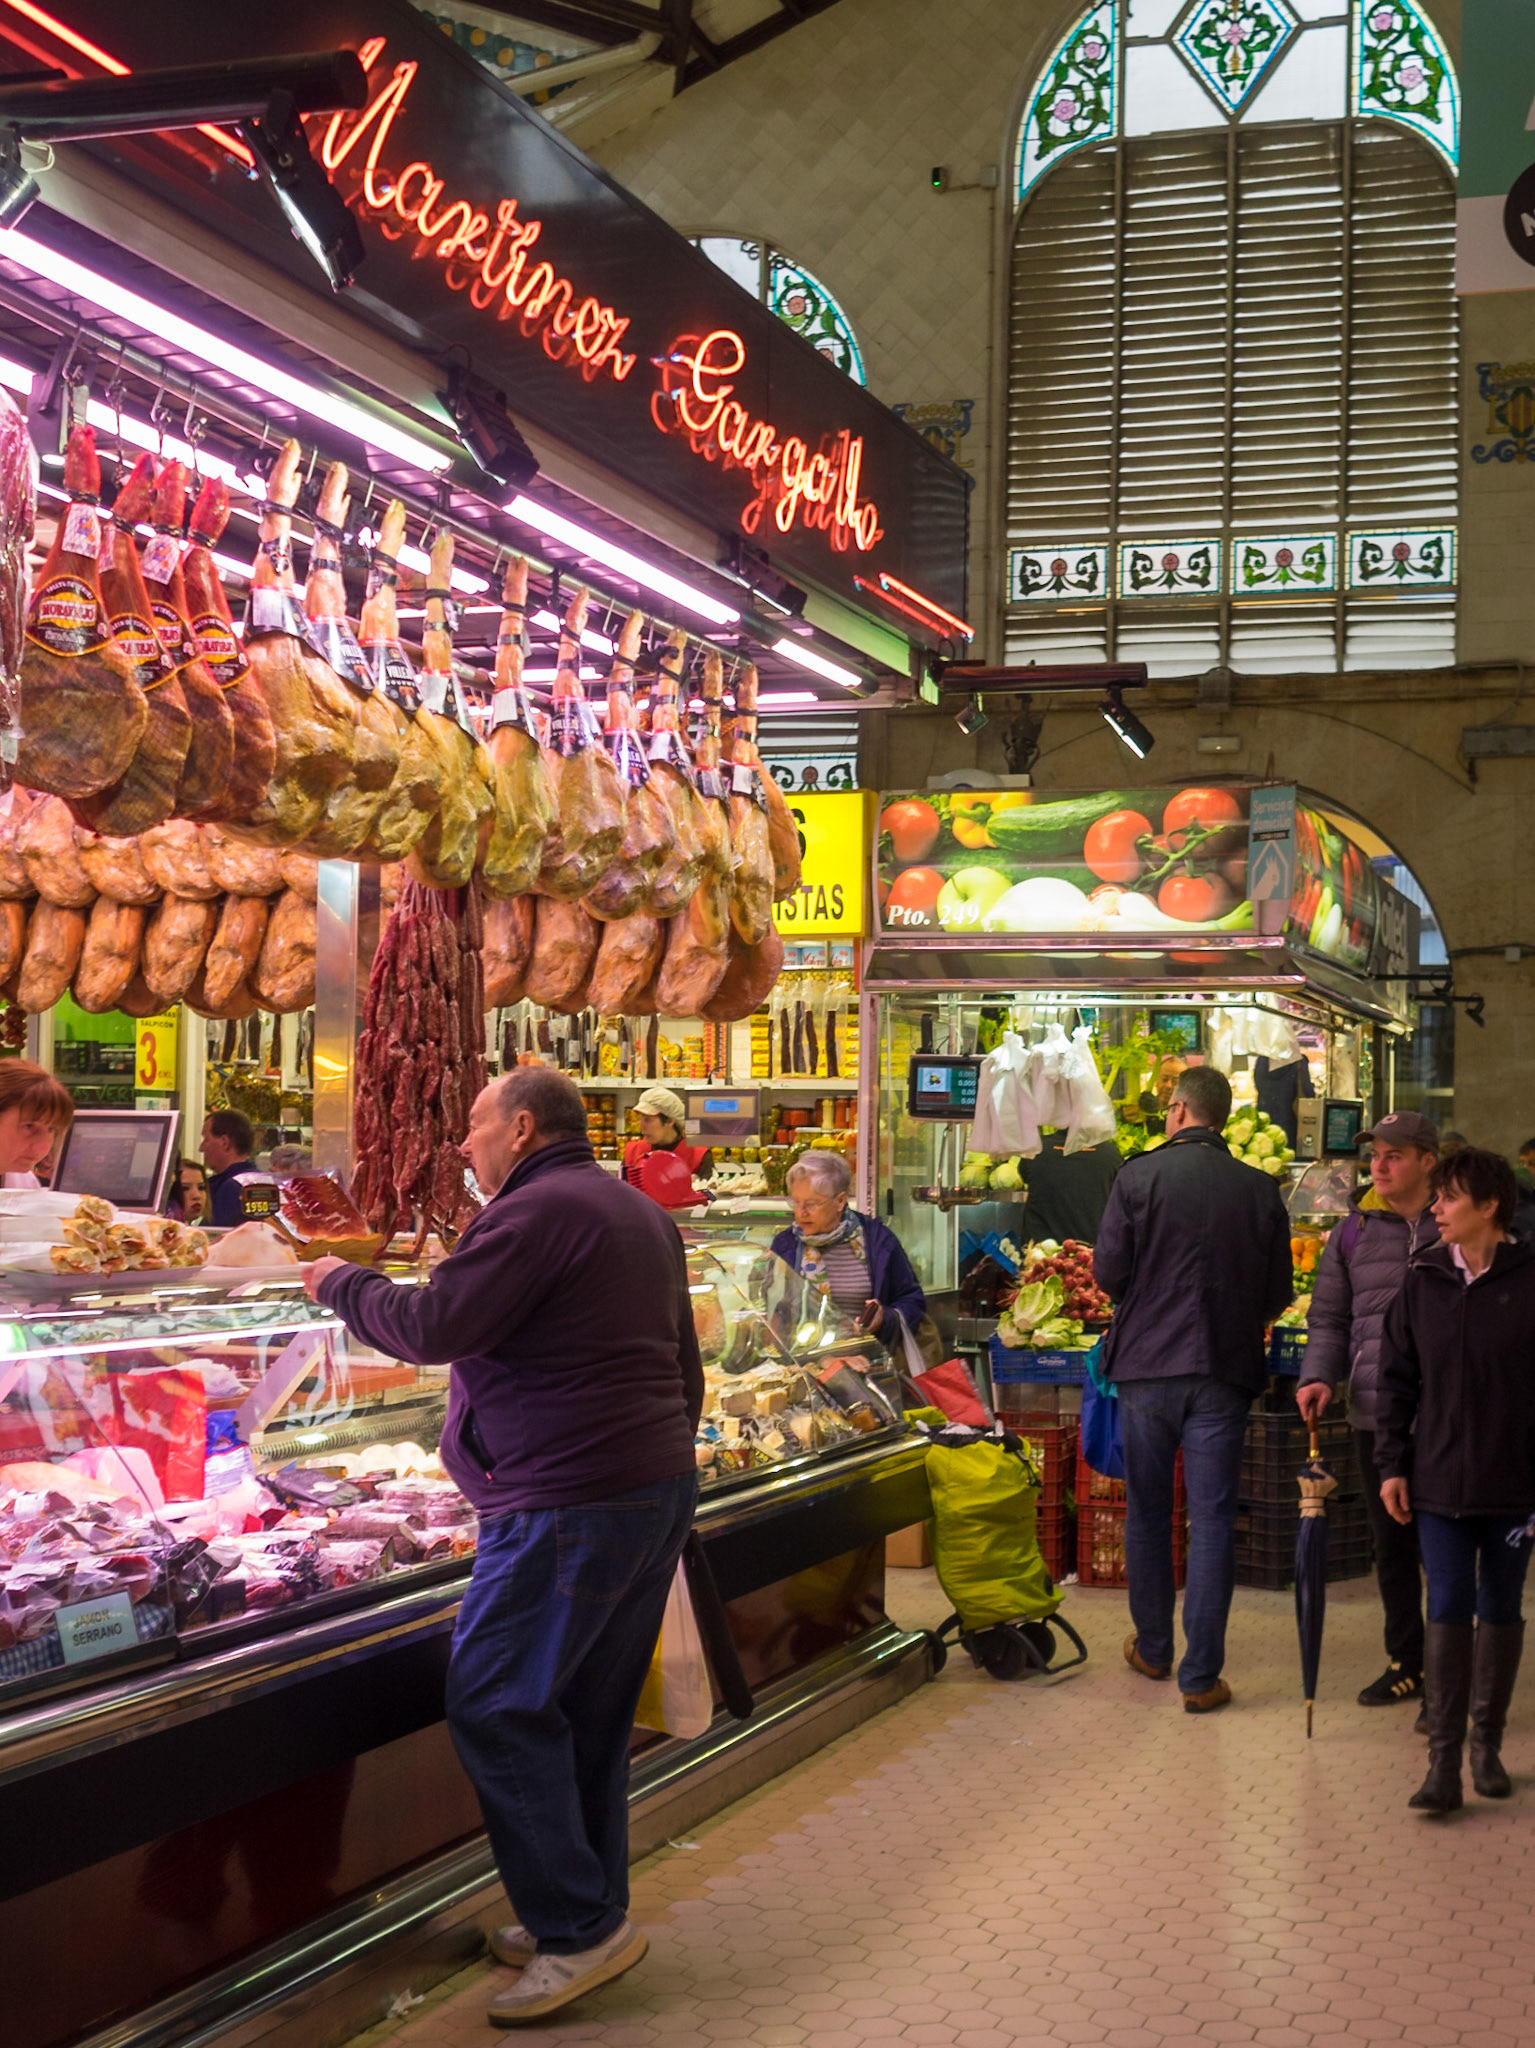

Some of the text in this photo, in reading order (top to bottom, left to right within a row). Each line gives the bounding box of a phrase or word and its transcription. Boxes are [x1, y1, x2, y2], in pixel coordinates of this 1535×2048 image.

[886, 904, 980, 926] Pto. 249
[139, 1031, 157, 1086] 3
[72, 1622, 122, 1647] SERRANO
